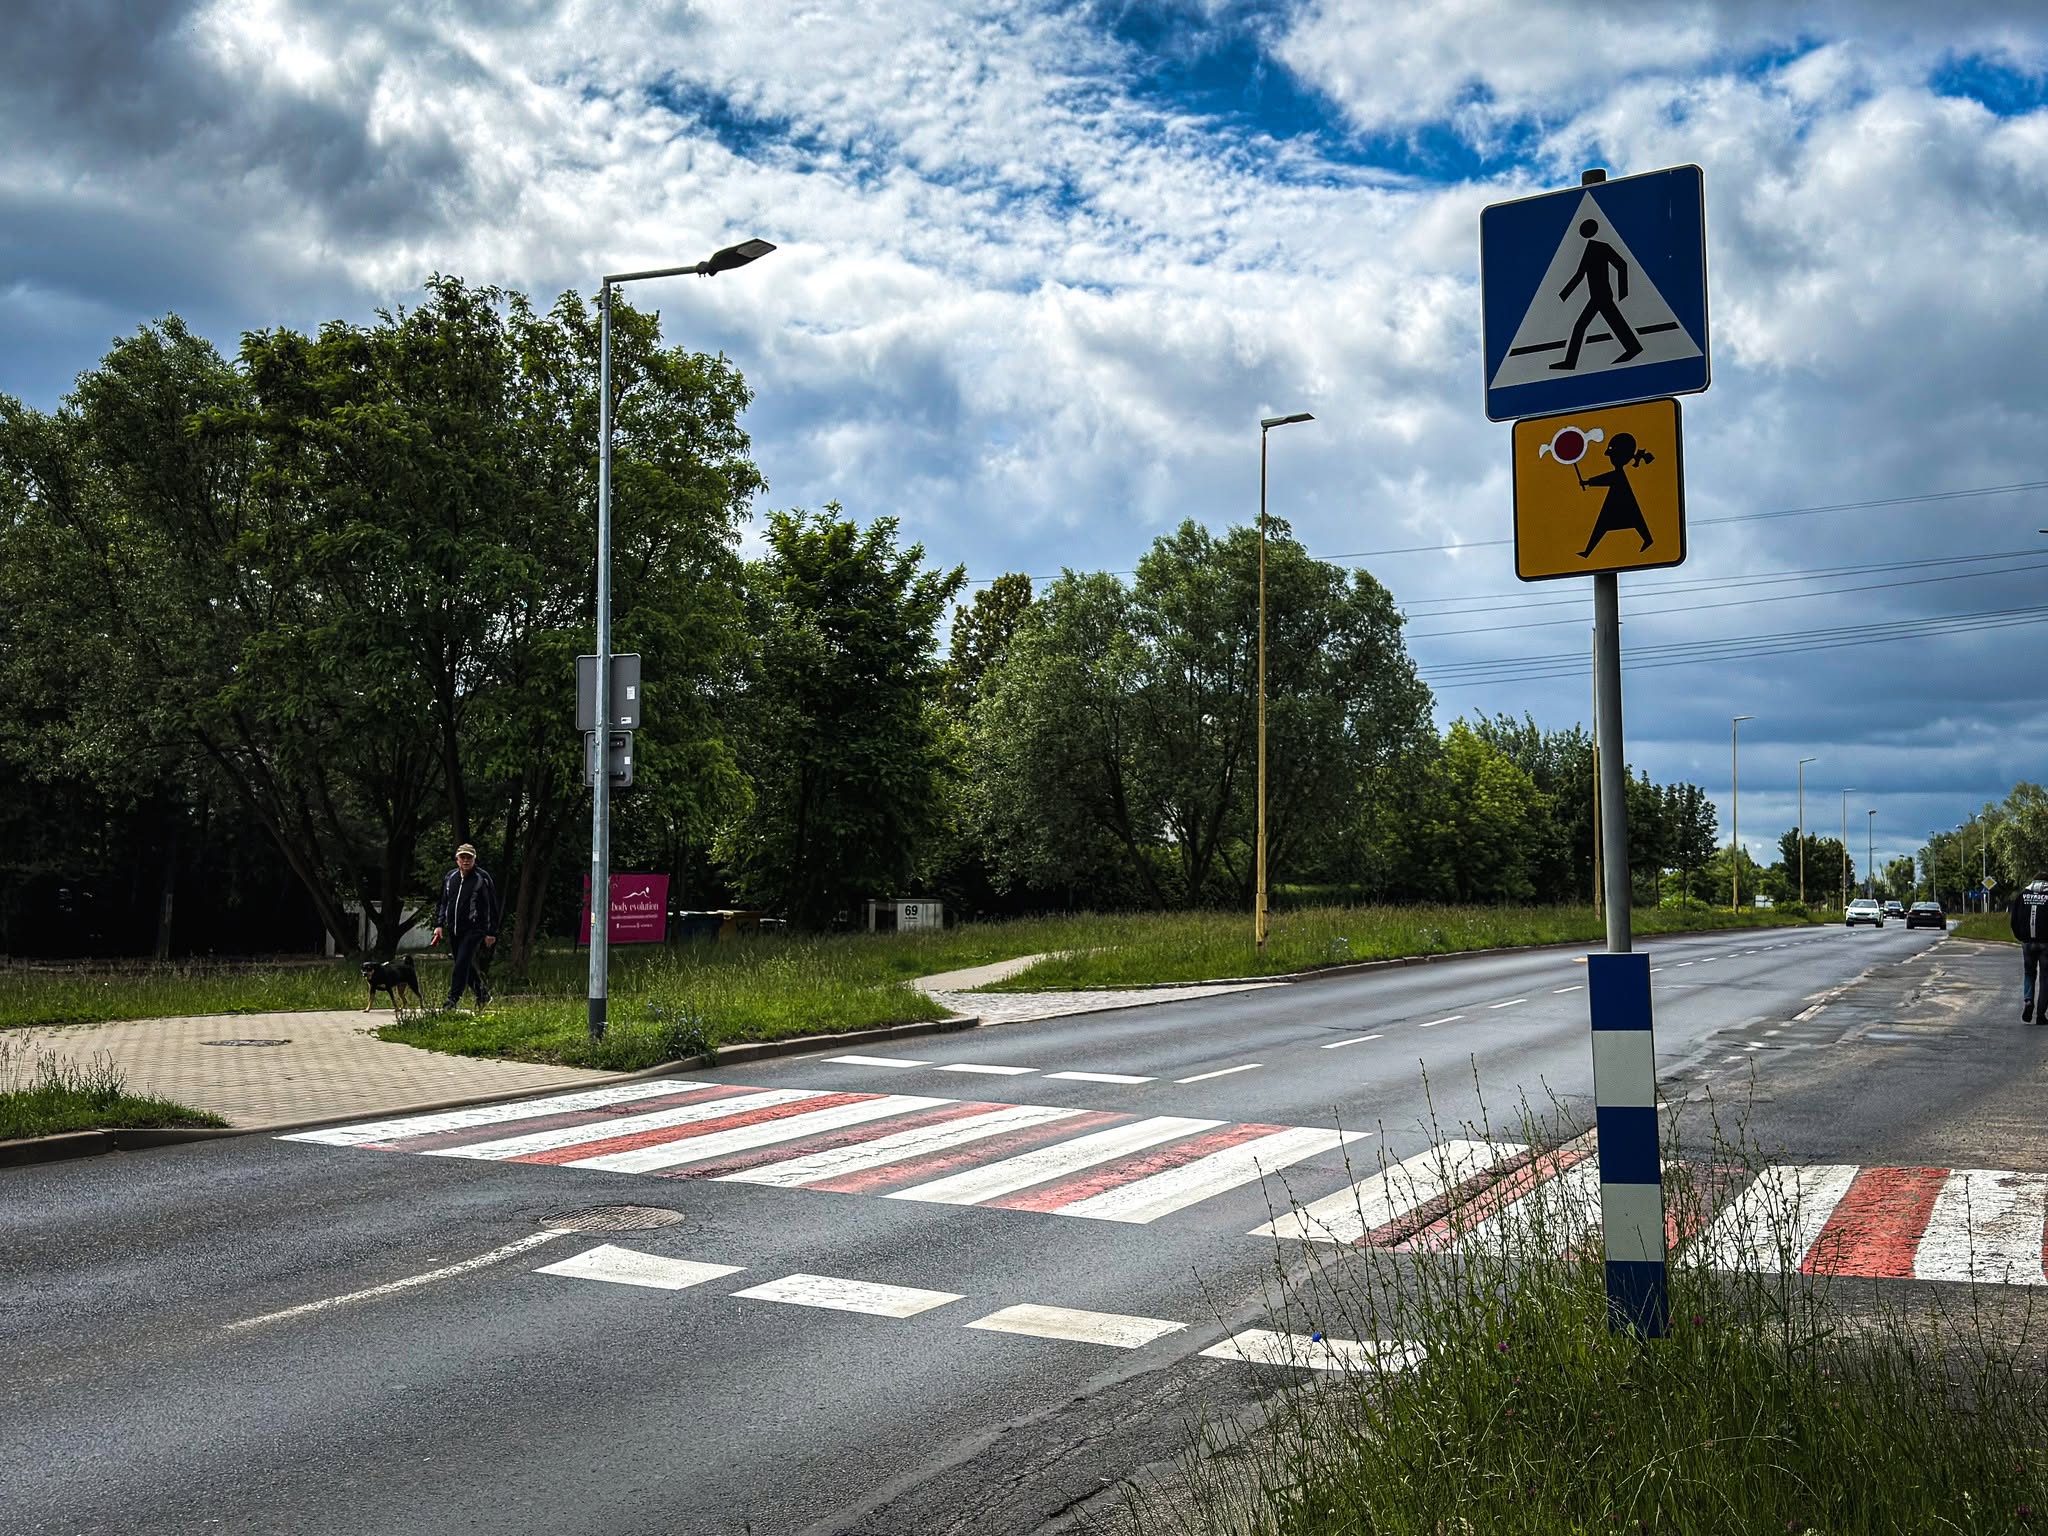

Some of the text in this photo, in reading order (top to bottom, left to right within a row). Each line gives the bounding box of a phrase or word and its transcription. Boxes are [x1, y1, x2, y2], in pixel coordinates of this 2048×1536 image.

[611, 901, 659, 913] body evolution
[904, 904, 918, 916] 69
